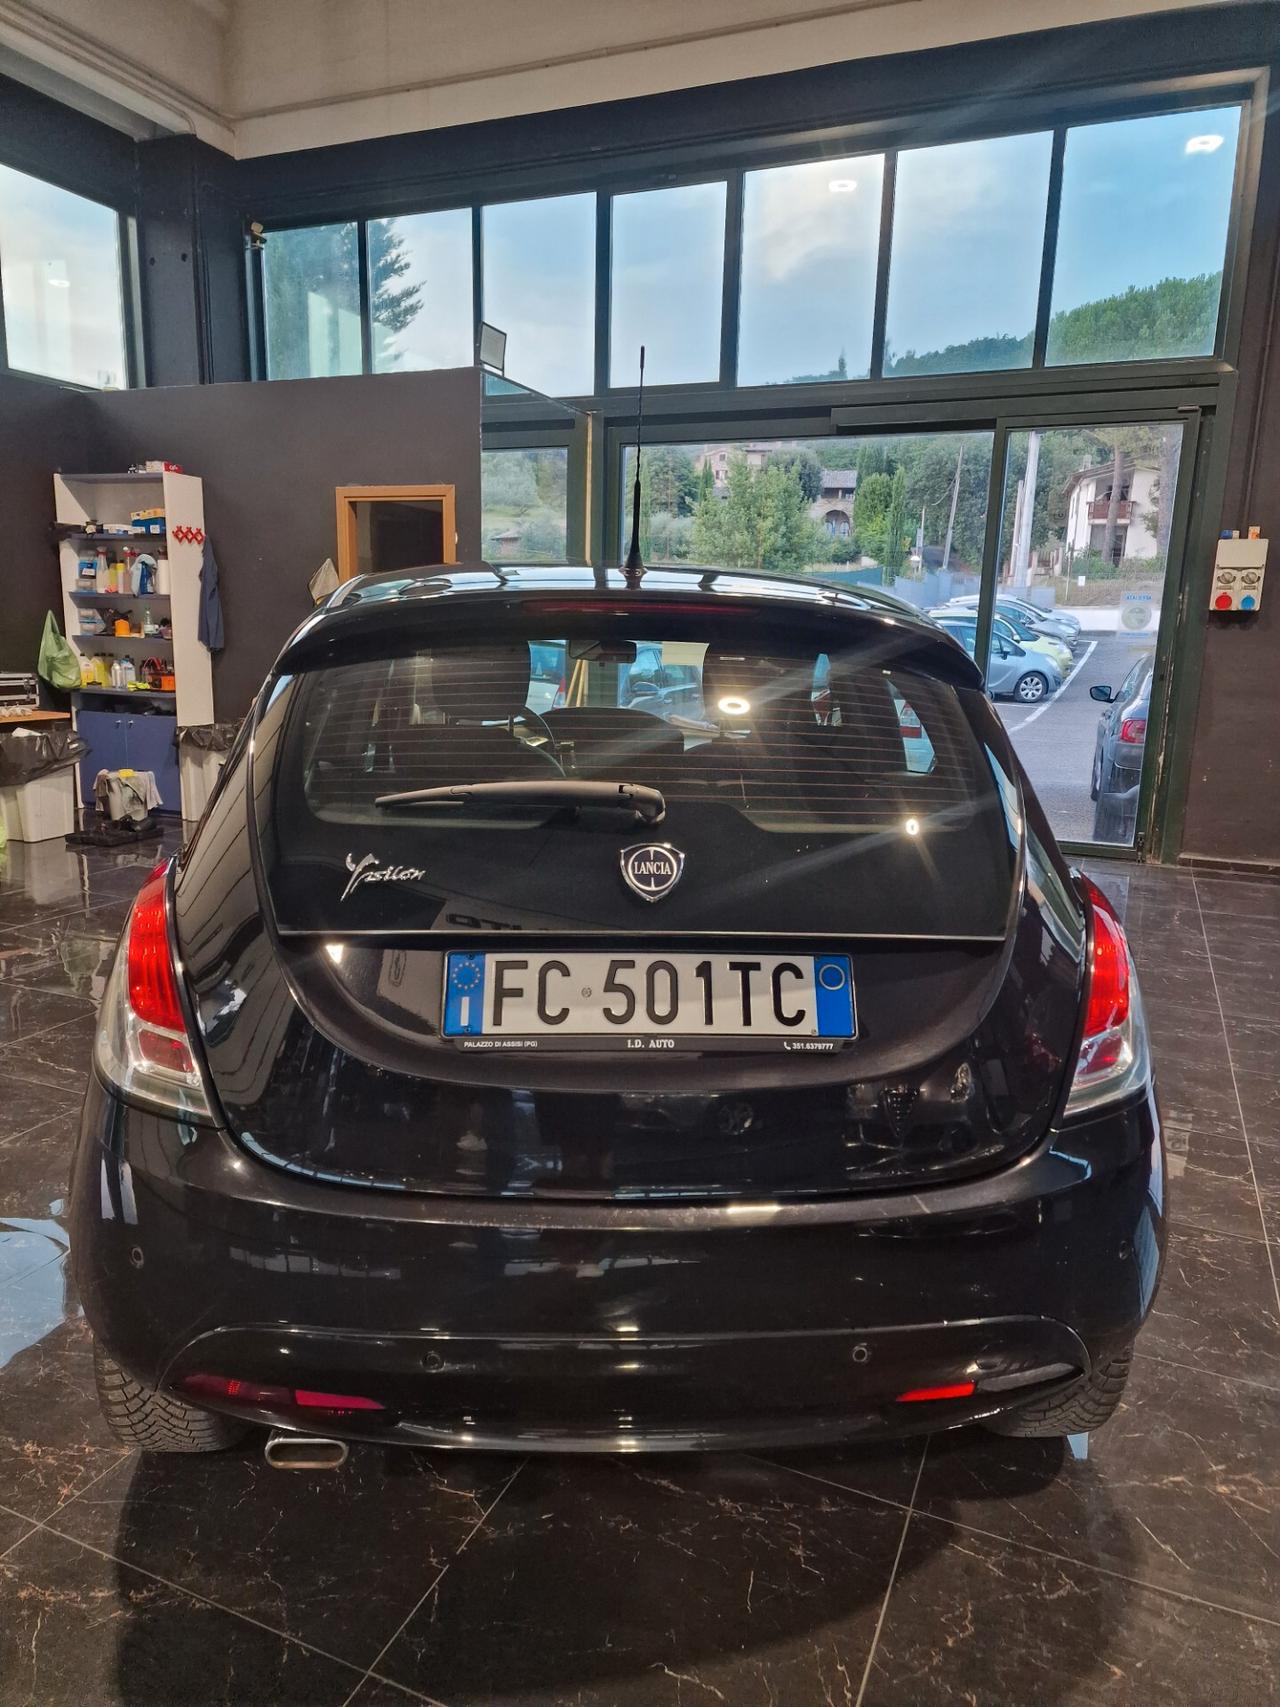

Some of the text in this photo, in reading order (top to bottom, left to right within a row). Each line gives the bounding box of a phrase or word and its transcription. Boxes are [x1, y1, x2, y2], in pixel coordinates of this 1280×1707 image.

[634, 861, 673, 875] LANCIA
[340, 852, 426, 901] Ypsilon
[493, 959, 806, 1027] FC 501TC
[463, 1040, 538, 1048] PALAZZO DI ASSISI (PG)
[627, 1039, 675, 1049] I.D. AUTO
